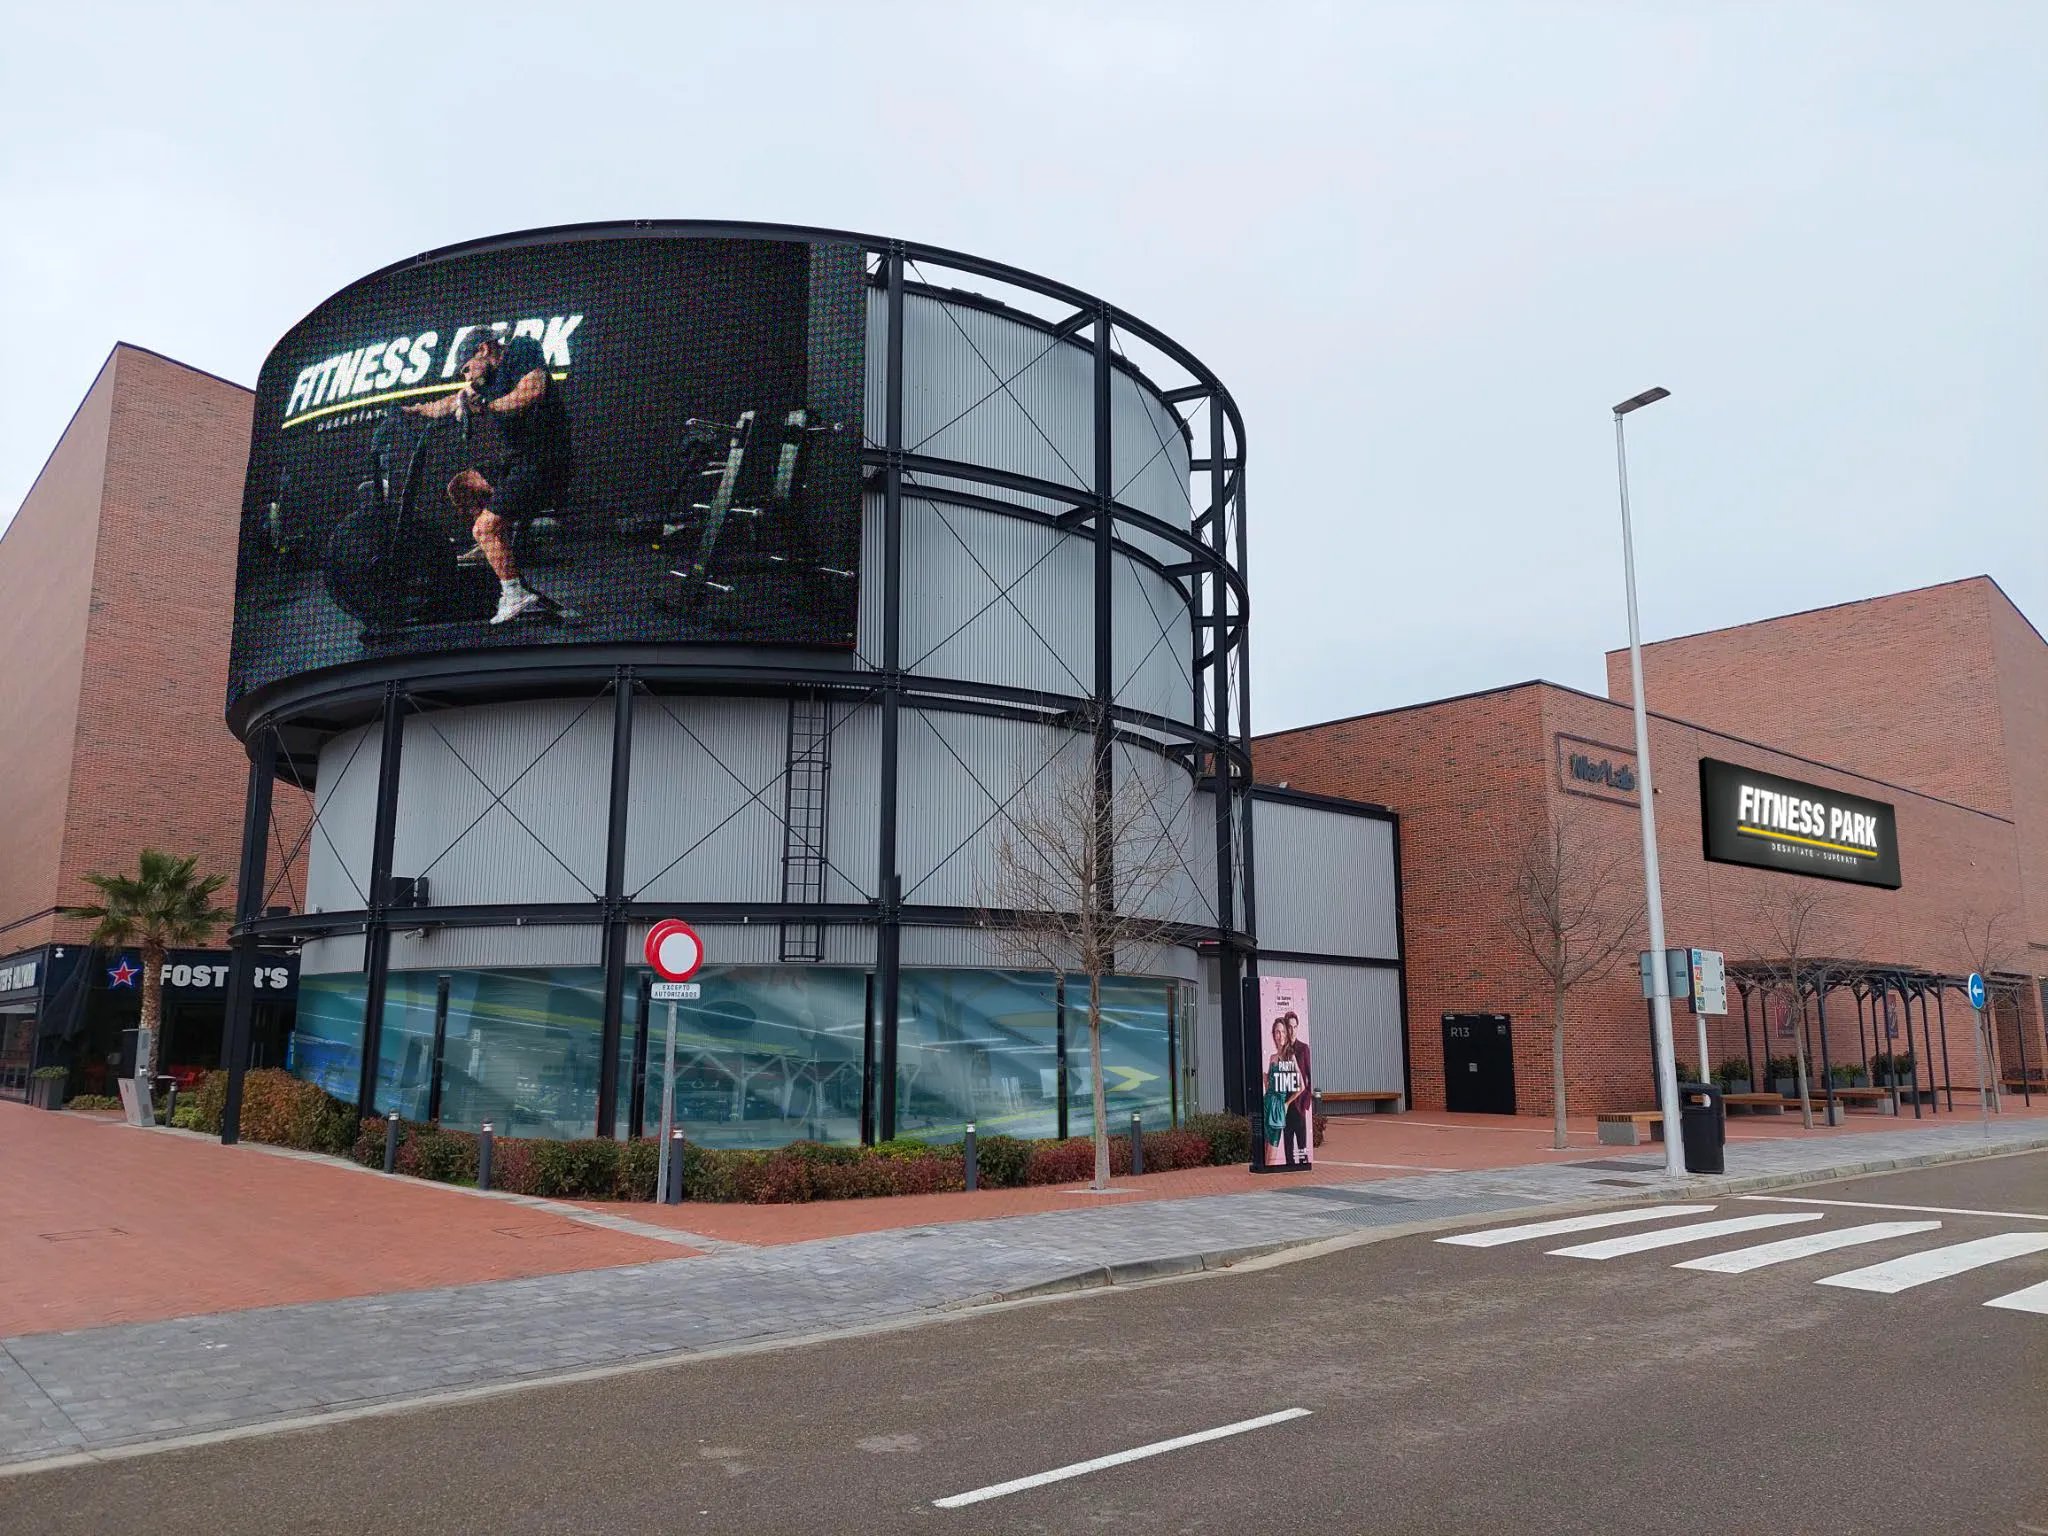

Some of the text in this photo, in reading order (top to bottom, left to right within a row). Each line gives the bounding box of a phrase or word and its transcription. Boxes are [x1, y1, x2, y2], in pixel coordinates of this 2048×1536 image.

[285, 331, 438, 417] FITNESS
[1738, 784, 1878, 848] FITNESS PARK
[160, 964, 289, 989] FOSTR'S
[1450, 1027, 1470, 1038] R13
[1278, 1061, 1296, 1072] PARTY
[1273, 1072, 1301, 1092] TIME!
